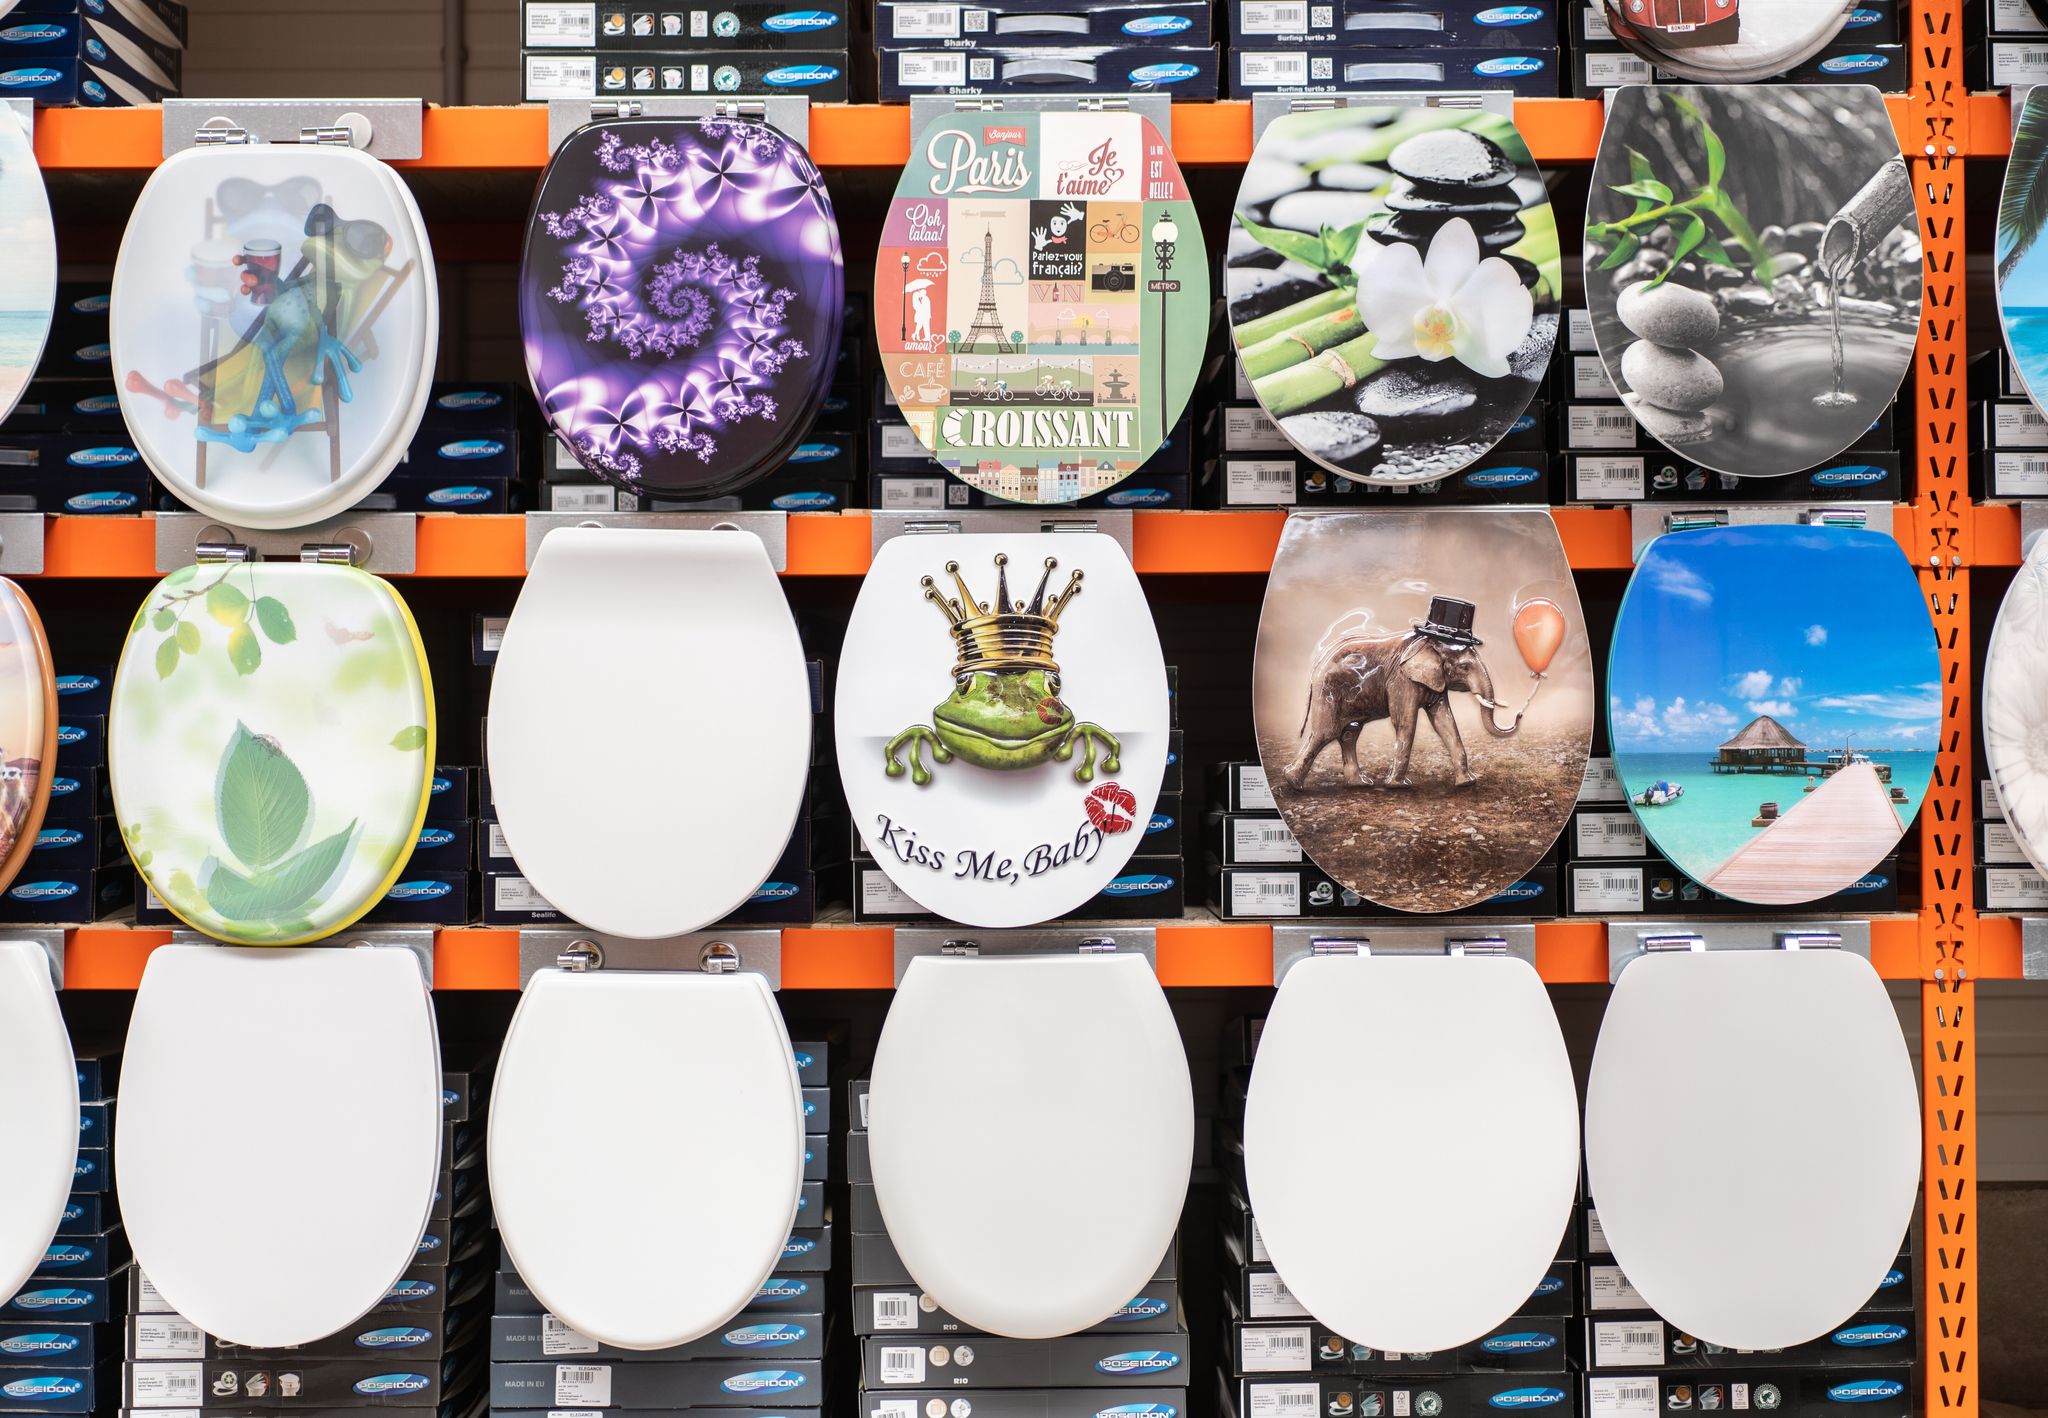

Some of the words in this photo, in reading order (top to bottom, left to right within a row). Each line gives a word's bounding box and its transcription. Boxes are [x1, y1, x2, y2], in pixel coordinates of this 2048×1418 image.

[1477, 11, 1537, 21] POSEIDON
[767, 17, 832, 26] POSEIDON
[1127, 22, 1187, 31] POSEIDON
[1277, 34, 1304, 43] Surfing
[1305, 34, 1326, 42] turtle
[943, 38, 977, 49] Sharky
[1478, 62, 1538, 72] POSEIDON
[1824, 60, 1883, 68] POSEIDON
[767, 71, 833, 80] POSEIDON
[1134, 68, 1193, 78] POSEIDON
[949, 86, 982, 96] Sharky
[988, 128, 1022, 141] Bonjour
[1087, 137, 1117, 176] Je
[926, 129, 1032, 195] Paris
[1150, 161, 1163, 178] EST
[1057, 173, 1110, 196] t'aime
[906, 203, 942, 227] Ooh
[1032, 251, 1083, 262] Parlez-vous
[1151, 281, 1177, 290] MÉTRO
[899, 358, 946, 378] CAFÉ
[71, 453, 133, 462] POSEIDON
[1470, 473, 1533, 482] POSEIDON
[1817, 473, 1882, 481] POSEIDON
[430, 492, 487, 500] POSEIDON
[70, 498, 131, 506] POSEIDON
[877, 813, 945, 871] Kiss
[954, 849, 1019, 886] Me,
[1105, 882, 1168, 890] POSEIDON
[12, 888, 72, 896] POSEIDON
[18, 1296, 87, 1305] POSEIDON
[360, 1334, 426, 1343] POSEIDON
[727, 1332, 800, 1342] POSEIDON
[1839, 1332, 1902, 1341] POSEIDON
[2, 1341, 72, 1350] POSEIDON
[1487, 1340, 1550, 1348] POSEIDON
[1100, 1359, 1172, 1368] POSEIDON
[359, 1380, 424, 1390] POSEIDON
[505, 1380, 526, 1388] MADE
[527, 1380, 535, 1388] IN
[536, 1380, 545, 1388] EU
[725, 1378, 798, 1388] POSEIDON
[5, 1385, 76, 1393] POSEIDON
[1834, 1387, 1897, 1396] POSEIDON
[1496, 1395, 1559, 1404] POSEIDON
